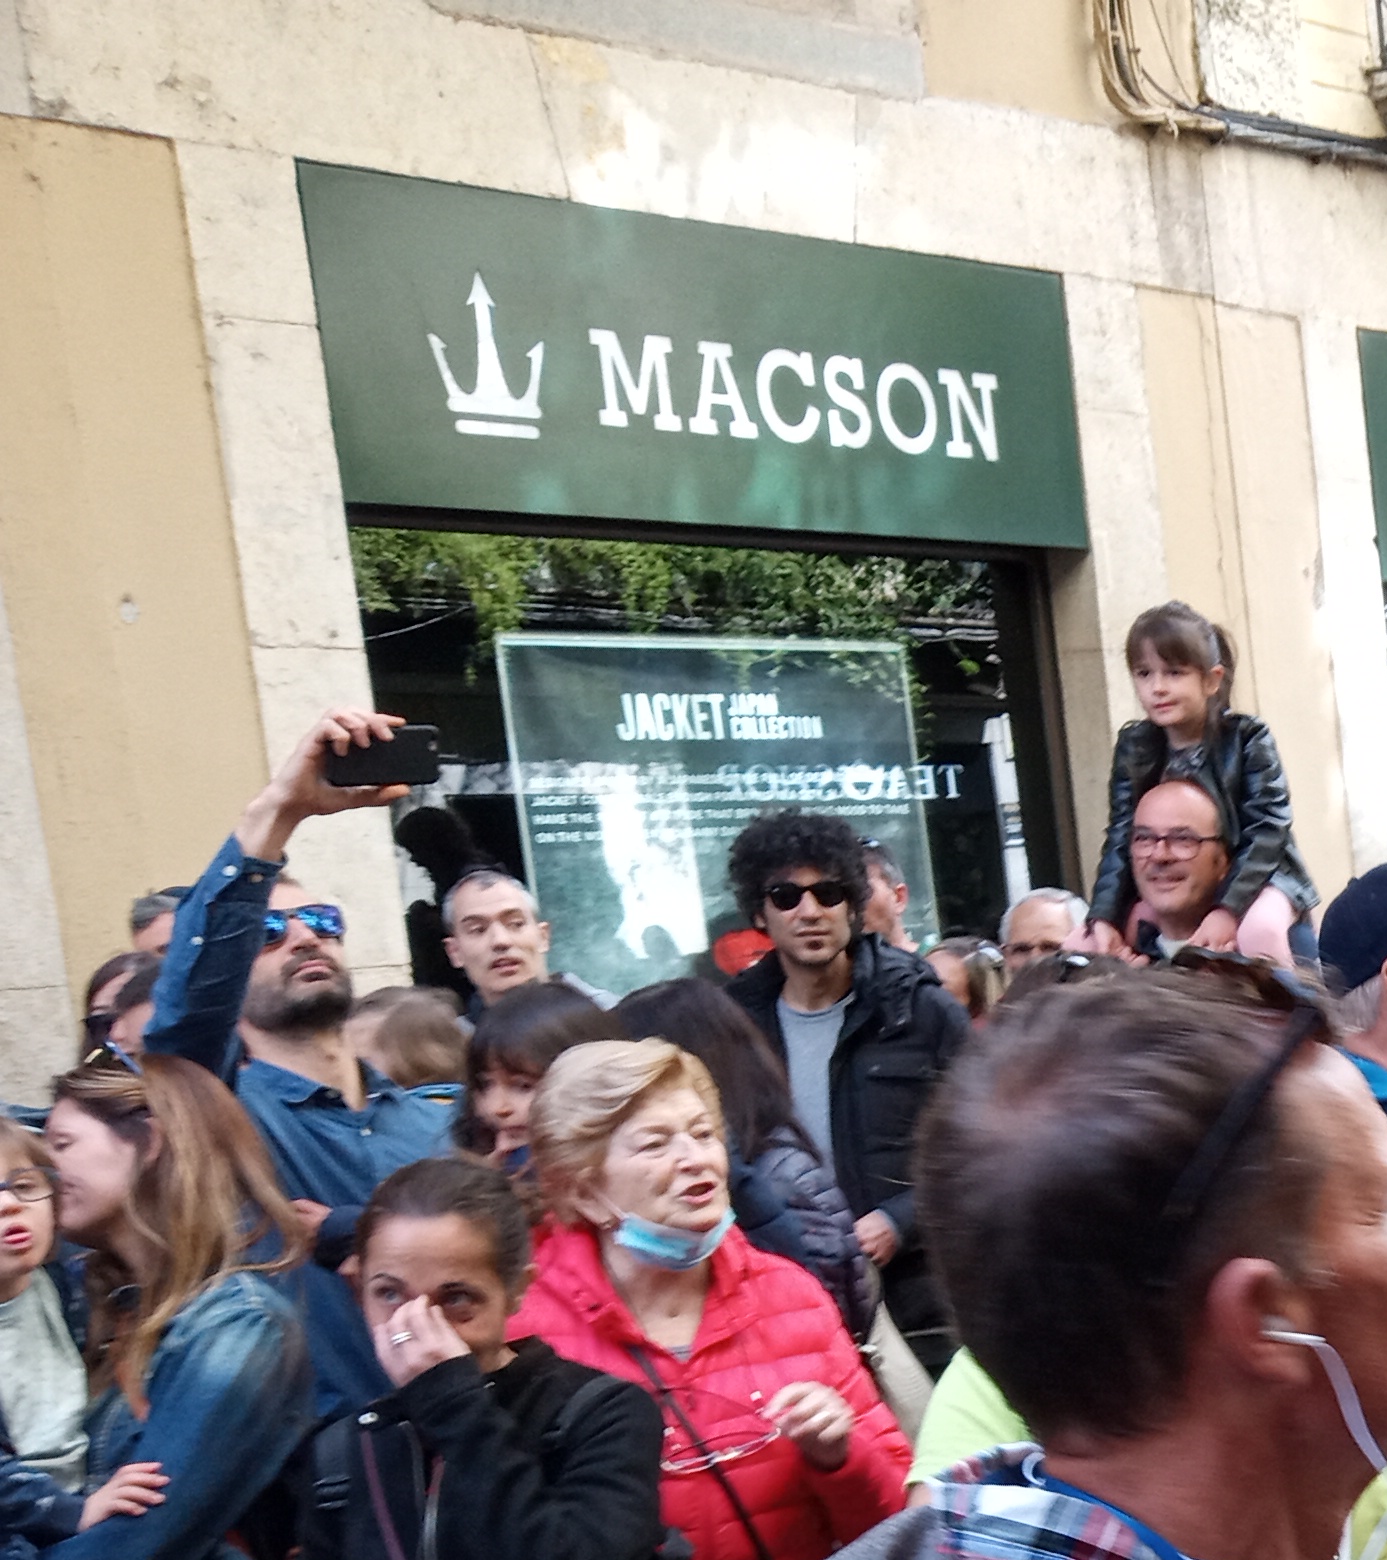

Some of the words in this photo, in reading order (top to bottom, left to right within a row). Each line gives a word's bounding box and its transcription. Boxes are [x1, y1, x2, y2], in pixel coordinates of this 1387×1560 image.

[588, 327, 999, 462] MACSON
[615, 692, 725, 741] JACKET
[730, 715, 824, 739] COLLECTION
